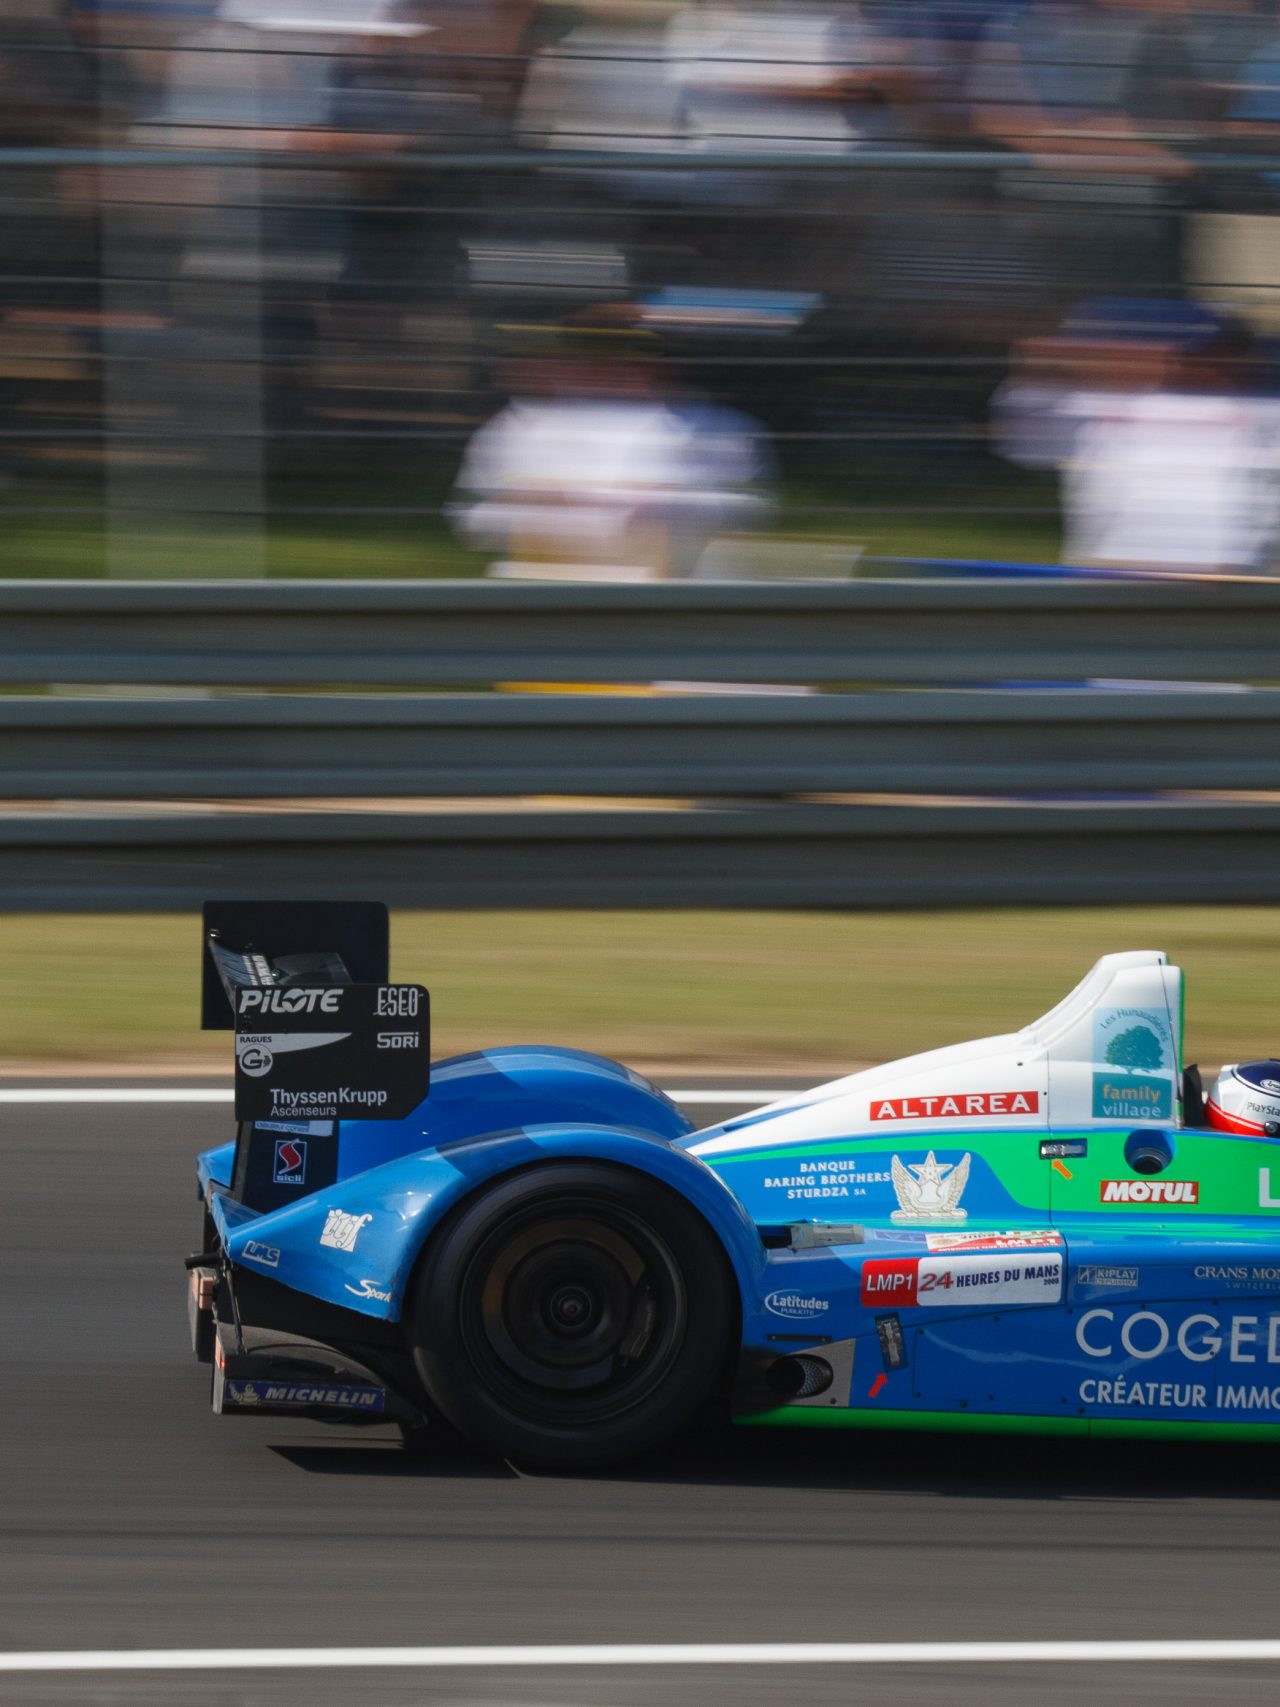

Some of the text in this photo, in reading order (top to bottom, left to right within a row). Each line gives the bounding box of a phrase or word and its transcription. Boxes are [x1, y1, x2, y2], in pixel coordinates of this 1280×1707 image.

[377, 987, 419, 1016] ESEO
[270, 1087, 388, 1107] ThyssenKrupp
[1103, 1084, 1161, 1105] family
[270, 1105, 337, 1117] Ascenseurs
[877, 1094, 1031, 1119] ALTAREA
[1102, 1102, 1161, 1120] village
[800, 1160, 856, 1173] BANQUE
[764, 1172, 891, 1188] BARING BROTHERS
[787, 1187, 866, 1199] STURDZA SA
[1103, 1181, 1197, 1202] MOTUL
[866, 1264, 1059, 1293] LMP1 24 HEURES DU MANS
[1194, 1265, 1248, 1279] CRANS
[773, 1294, 829, 1310] Latitudes
[265, 1387, 376, 1405] MICHELIN
[1079, 1374, 1207, 1408] CRÉATEUR
